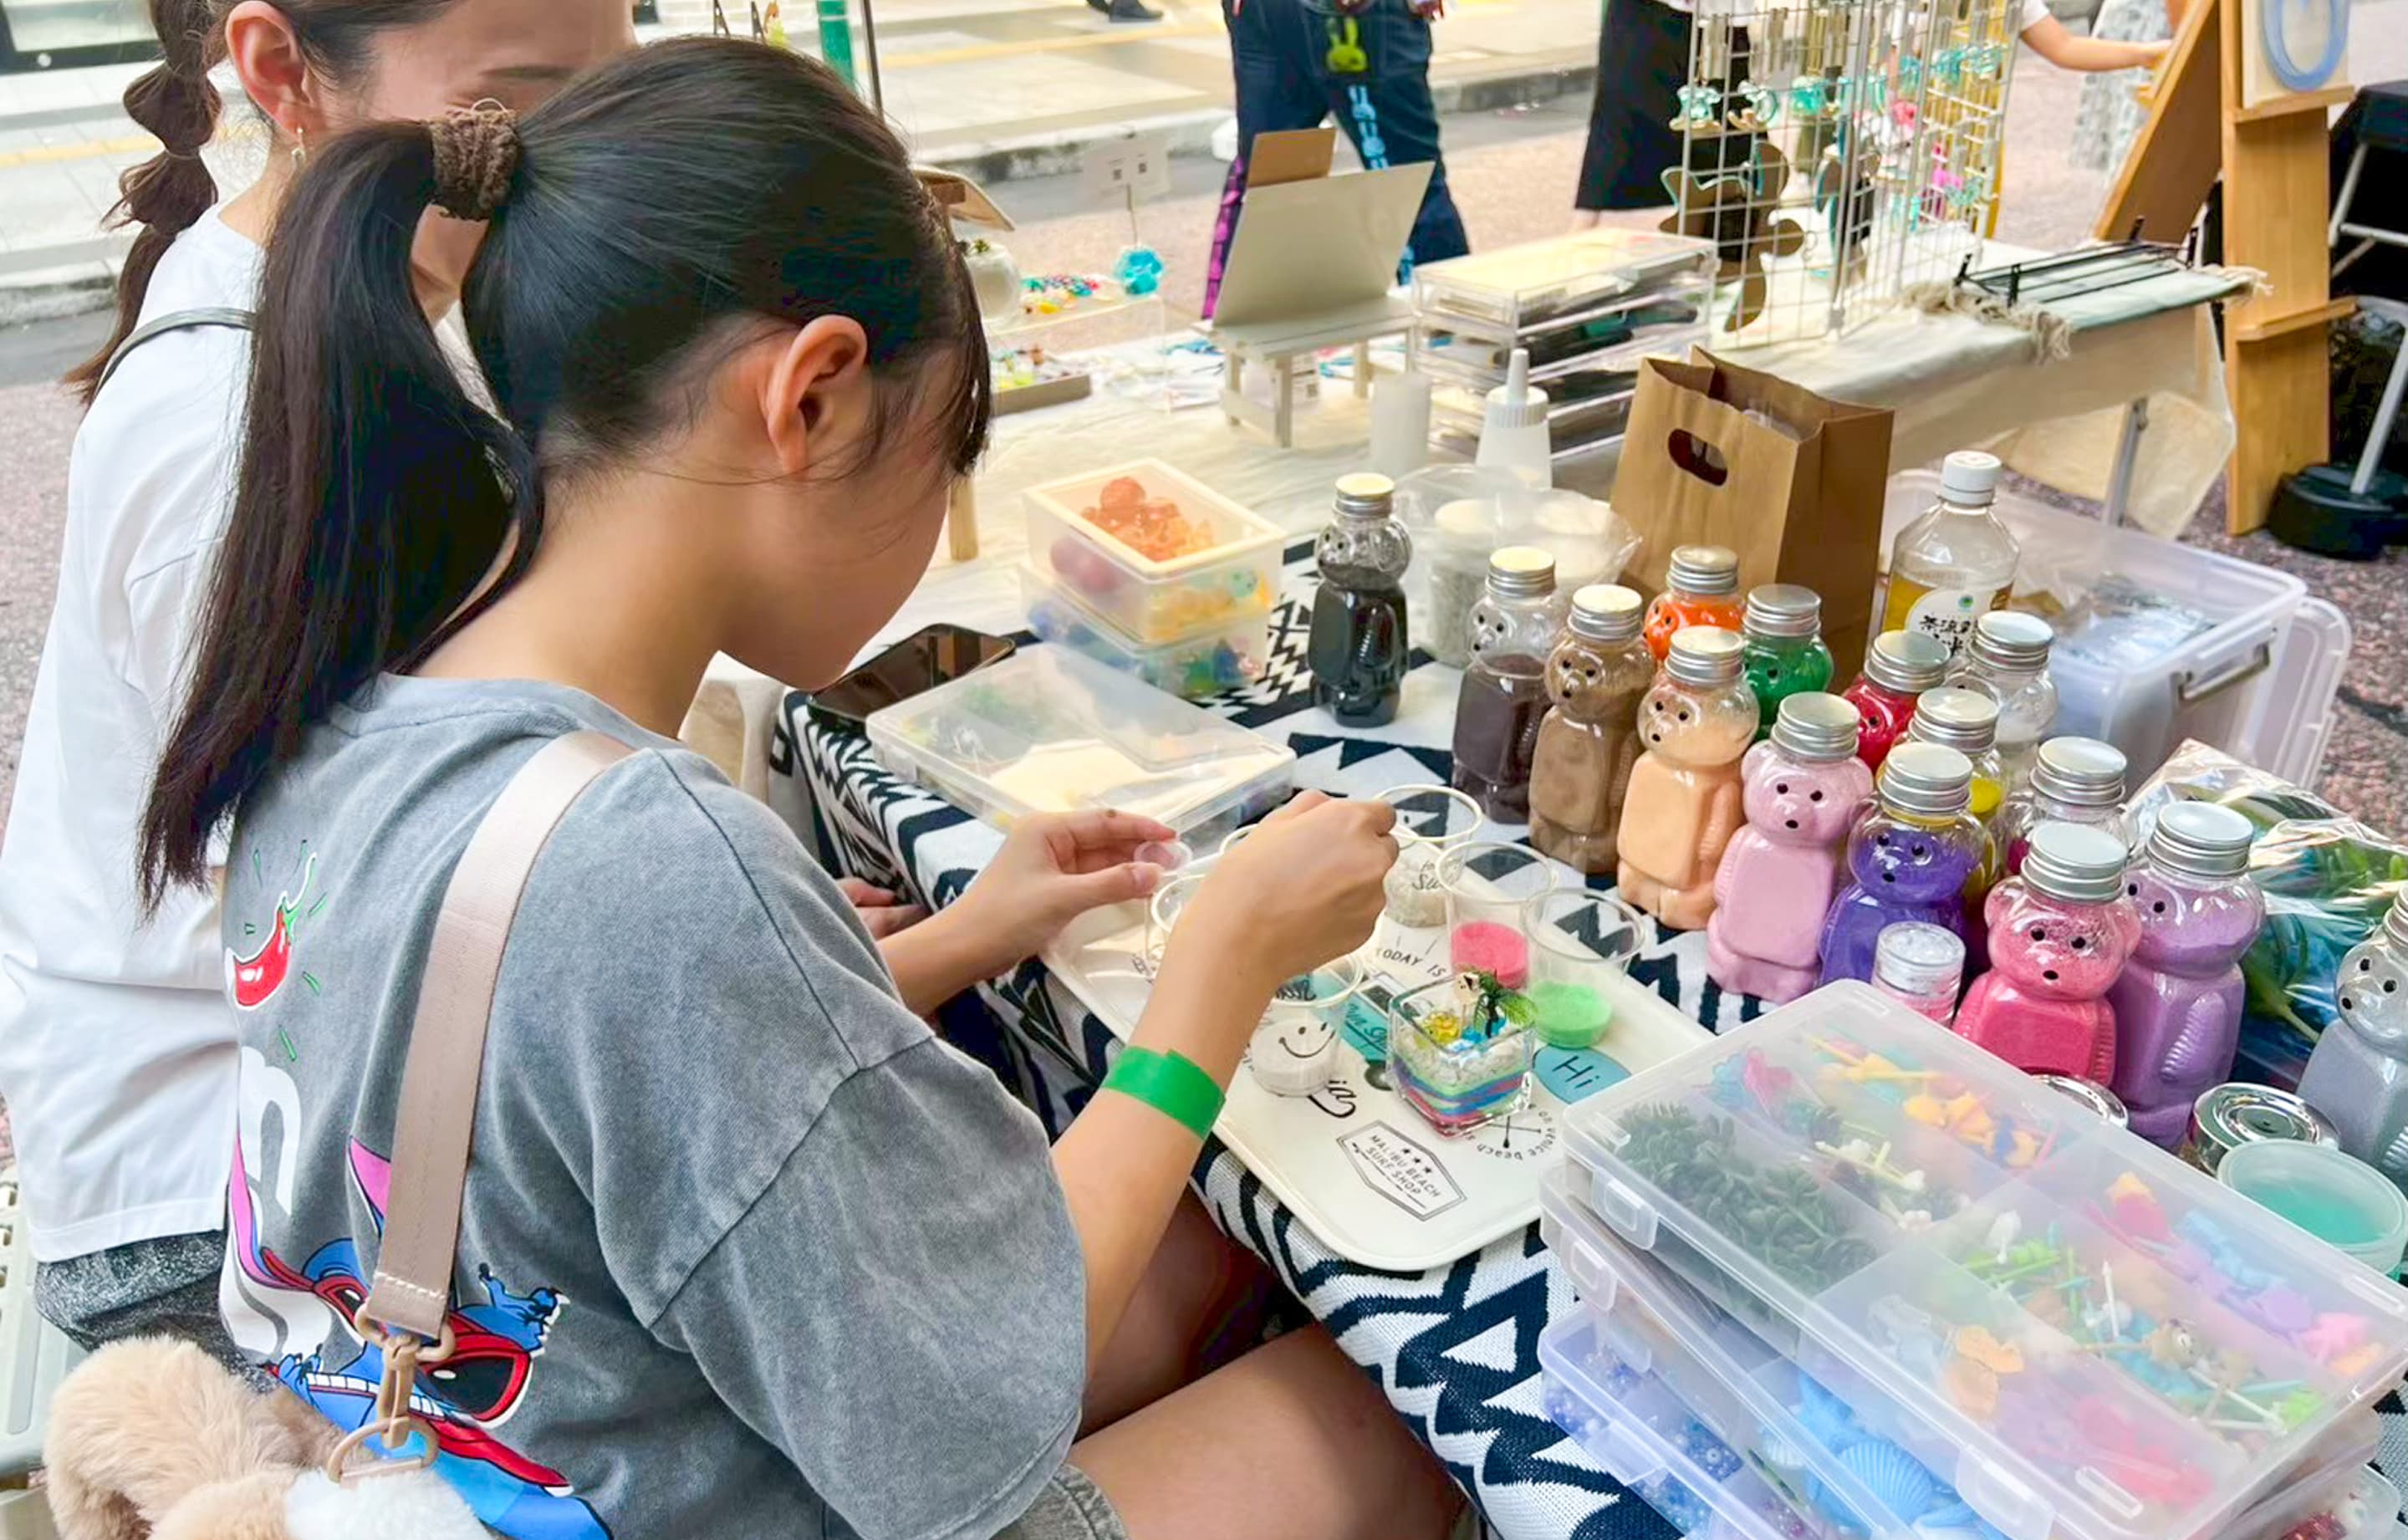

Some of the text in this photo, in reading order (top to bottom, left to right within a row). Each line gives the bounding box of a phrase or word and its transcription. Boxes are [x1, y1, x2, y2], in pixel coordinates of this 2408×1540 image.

[1426, 964, 1447, 977] IS
[1551, 1054, 1601, 1090] Hi
[1370, 1134, 1441, 1198] MALIBU BEACH
[1476, 1143, 1524, 1161] beach
[1365, 1146, 1422, 1195] SURF SHOP
